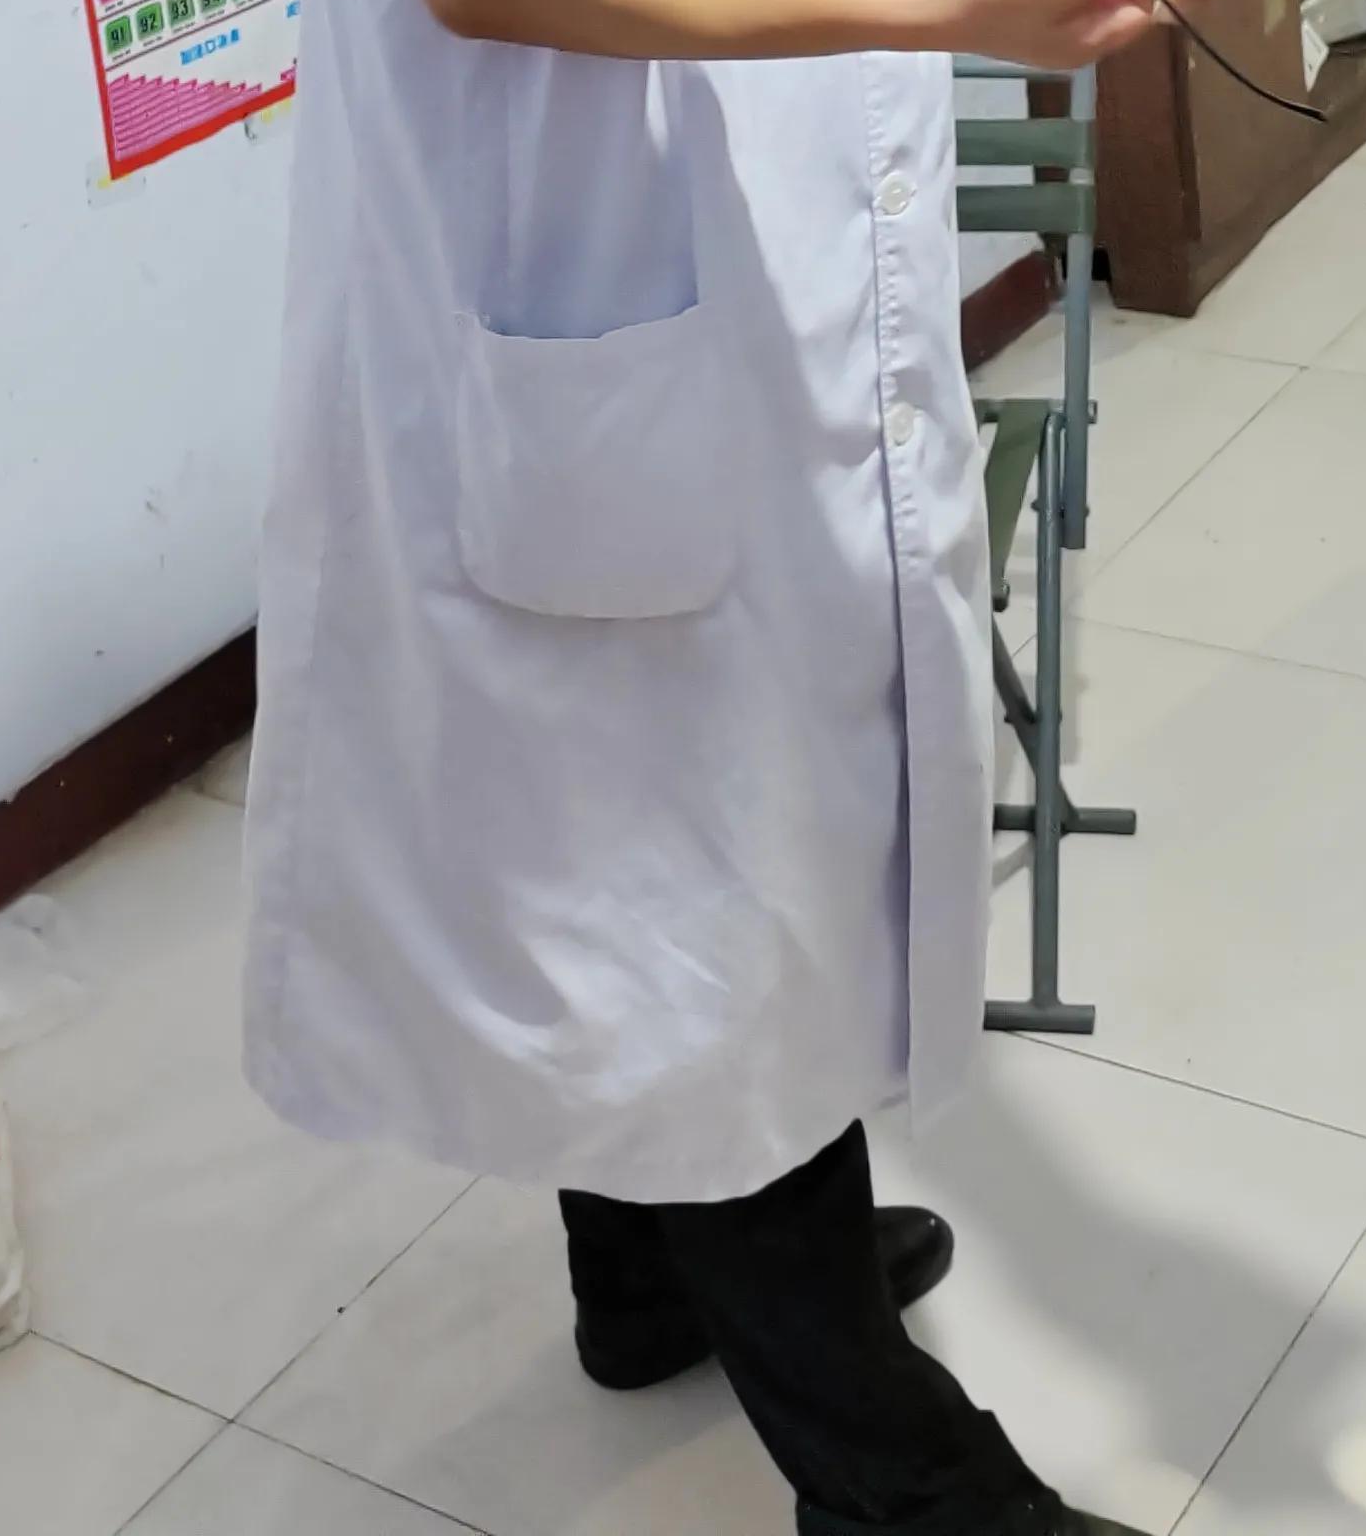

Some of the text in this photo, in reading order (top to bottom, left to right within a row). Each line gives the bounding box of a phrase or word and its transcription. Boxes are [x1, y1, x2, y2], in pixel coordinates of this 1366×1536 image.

[111, 26, 125, 43] 91
[141, 14, 155, 32] 92
[172, 1, 188, 18] 93
